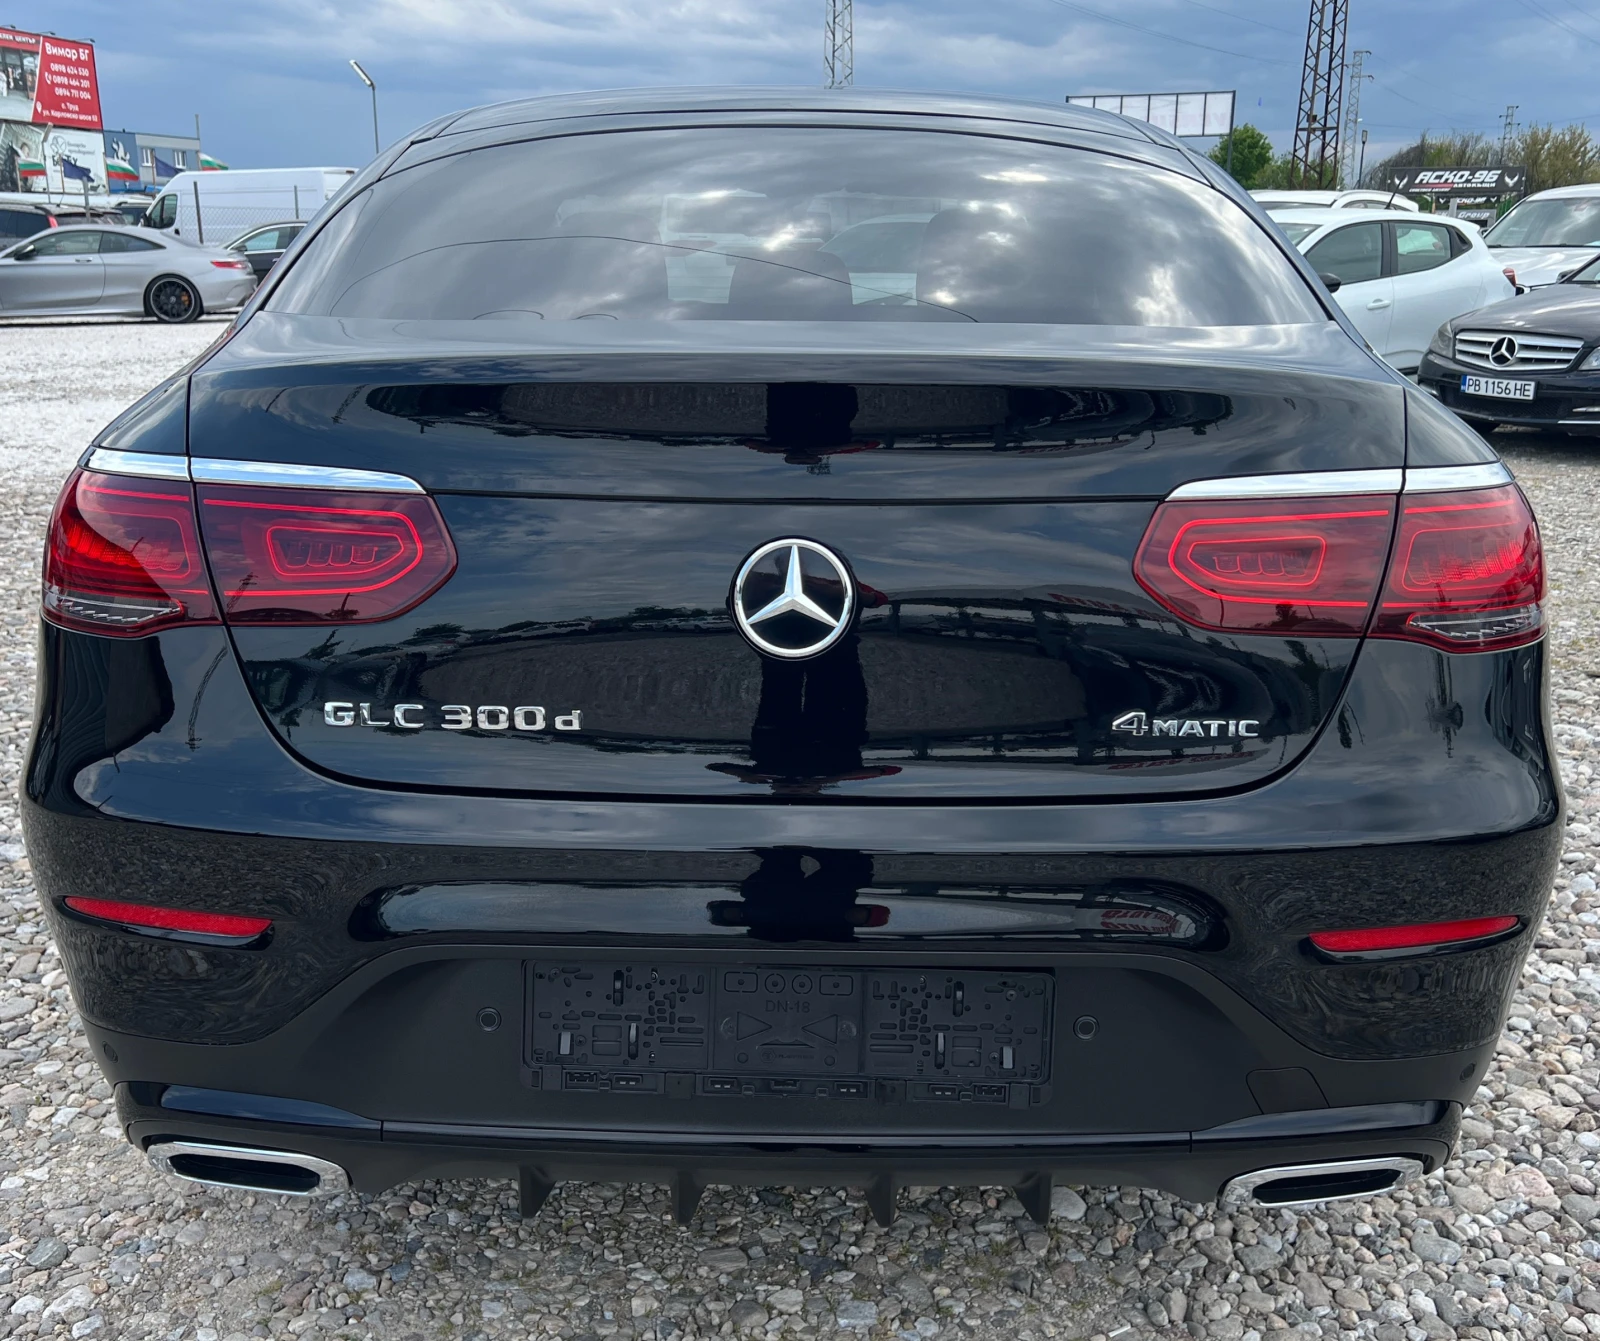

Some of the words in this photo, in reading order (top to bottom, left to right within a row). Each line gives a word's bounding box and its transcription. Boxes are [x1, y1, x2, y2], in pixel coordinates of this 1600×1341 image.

[45, 42, 78, 61] Вимар
[79, 48, 89, 61] БГ
[1414, 170, 1502, 183] АСКО-96
[1467, 379, 1480, 391] PB
[1485, 380, 1511, 395] 1156
[1514, 382, 1532, 397] HE
[324, 702, 425, 728] GLC
[1112, 711, 1260, 737] 4MATIC
[765, 1000, 811, 1013] DN-18
